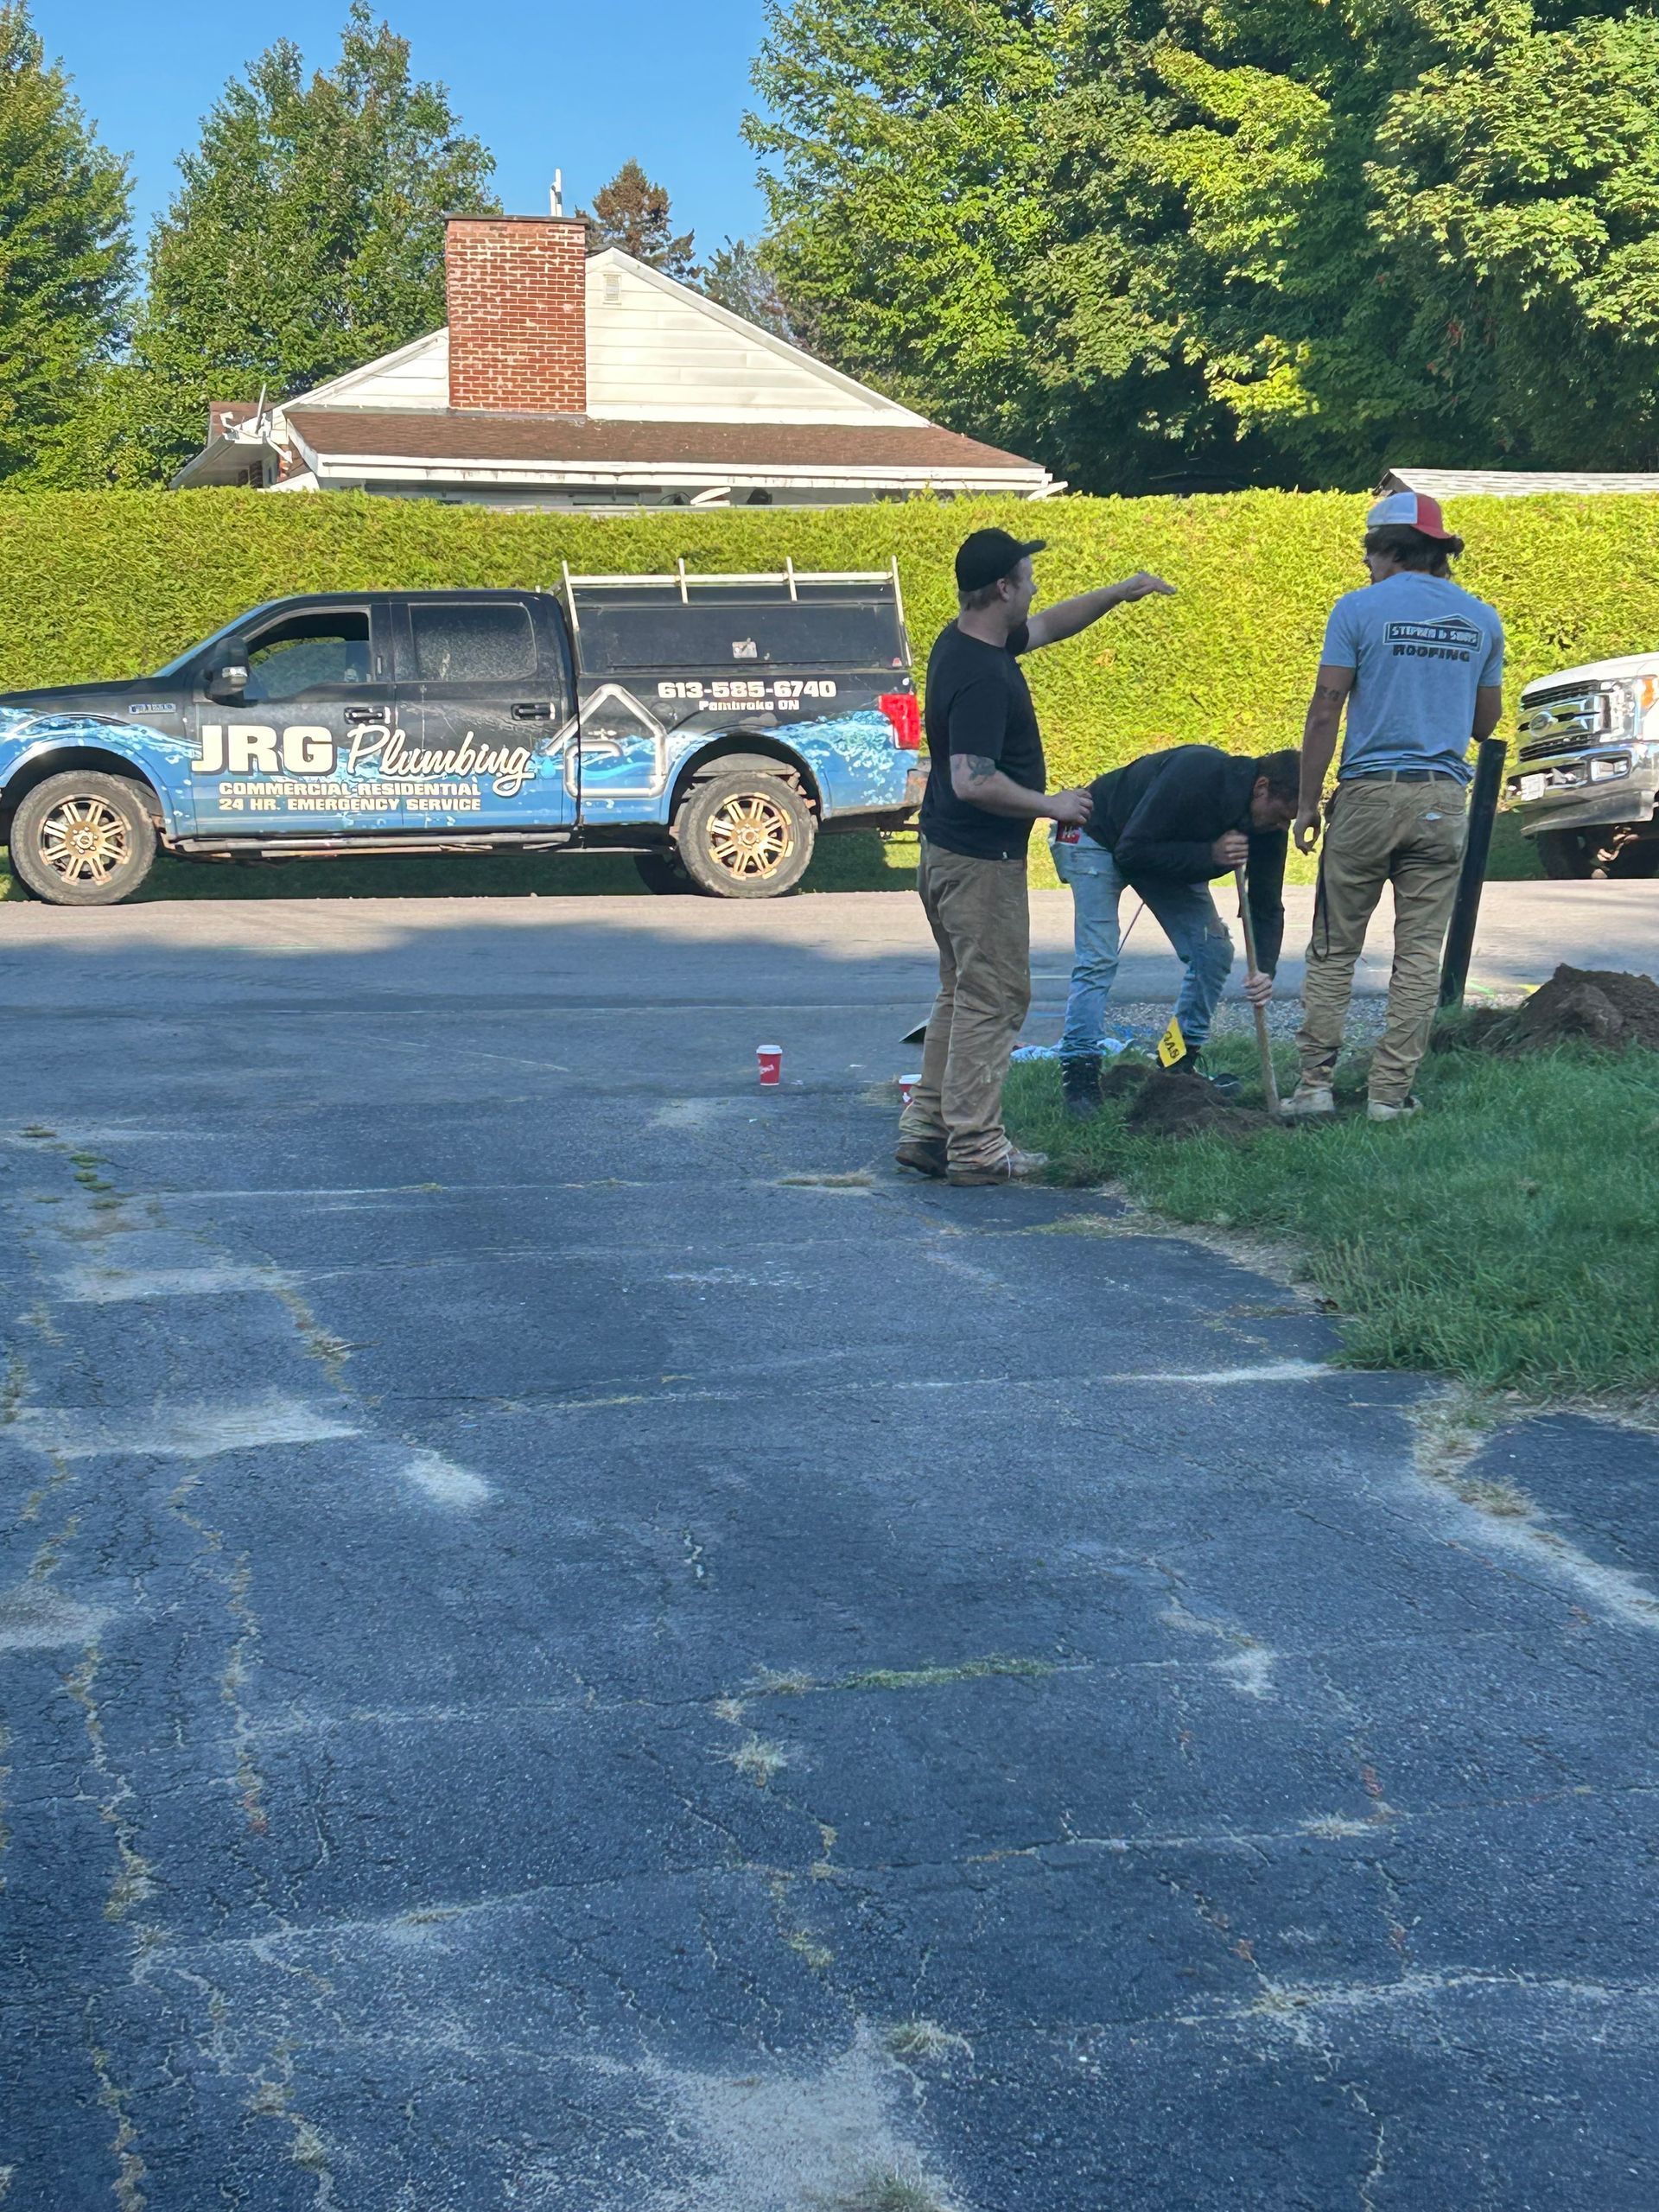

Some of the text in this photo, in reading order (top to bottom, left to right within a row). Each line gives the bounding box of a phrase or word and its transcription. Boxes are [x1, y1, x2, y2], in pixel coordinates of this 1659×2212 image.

[1391, 626, 1436, 639] STEPHEN
[1393, 645, 1470, 662] ROOFING
[657, 681, 837, 698] 613-585-6740
[778, 700, 800, 711] ON
[191, 723, 535, 797] JRG Plumbing
[219, 798, 481, 810] 24 HR. EMERGENCY SERVICE
